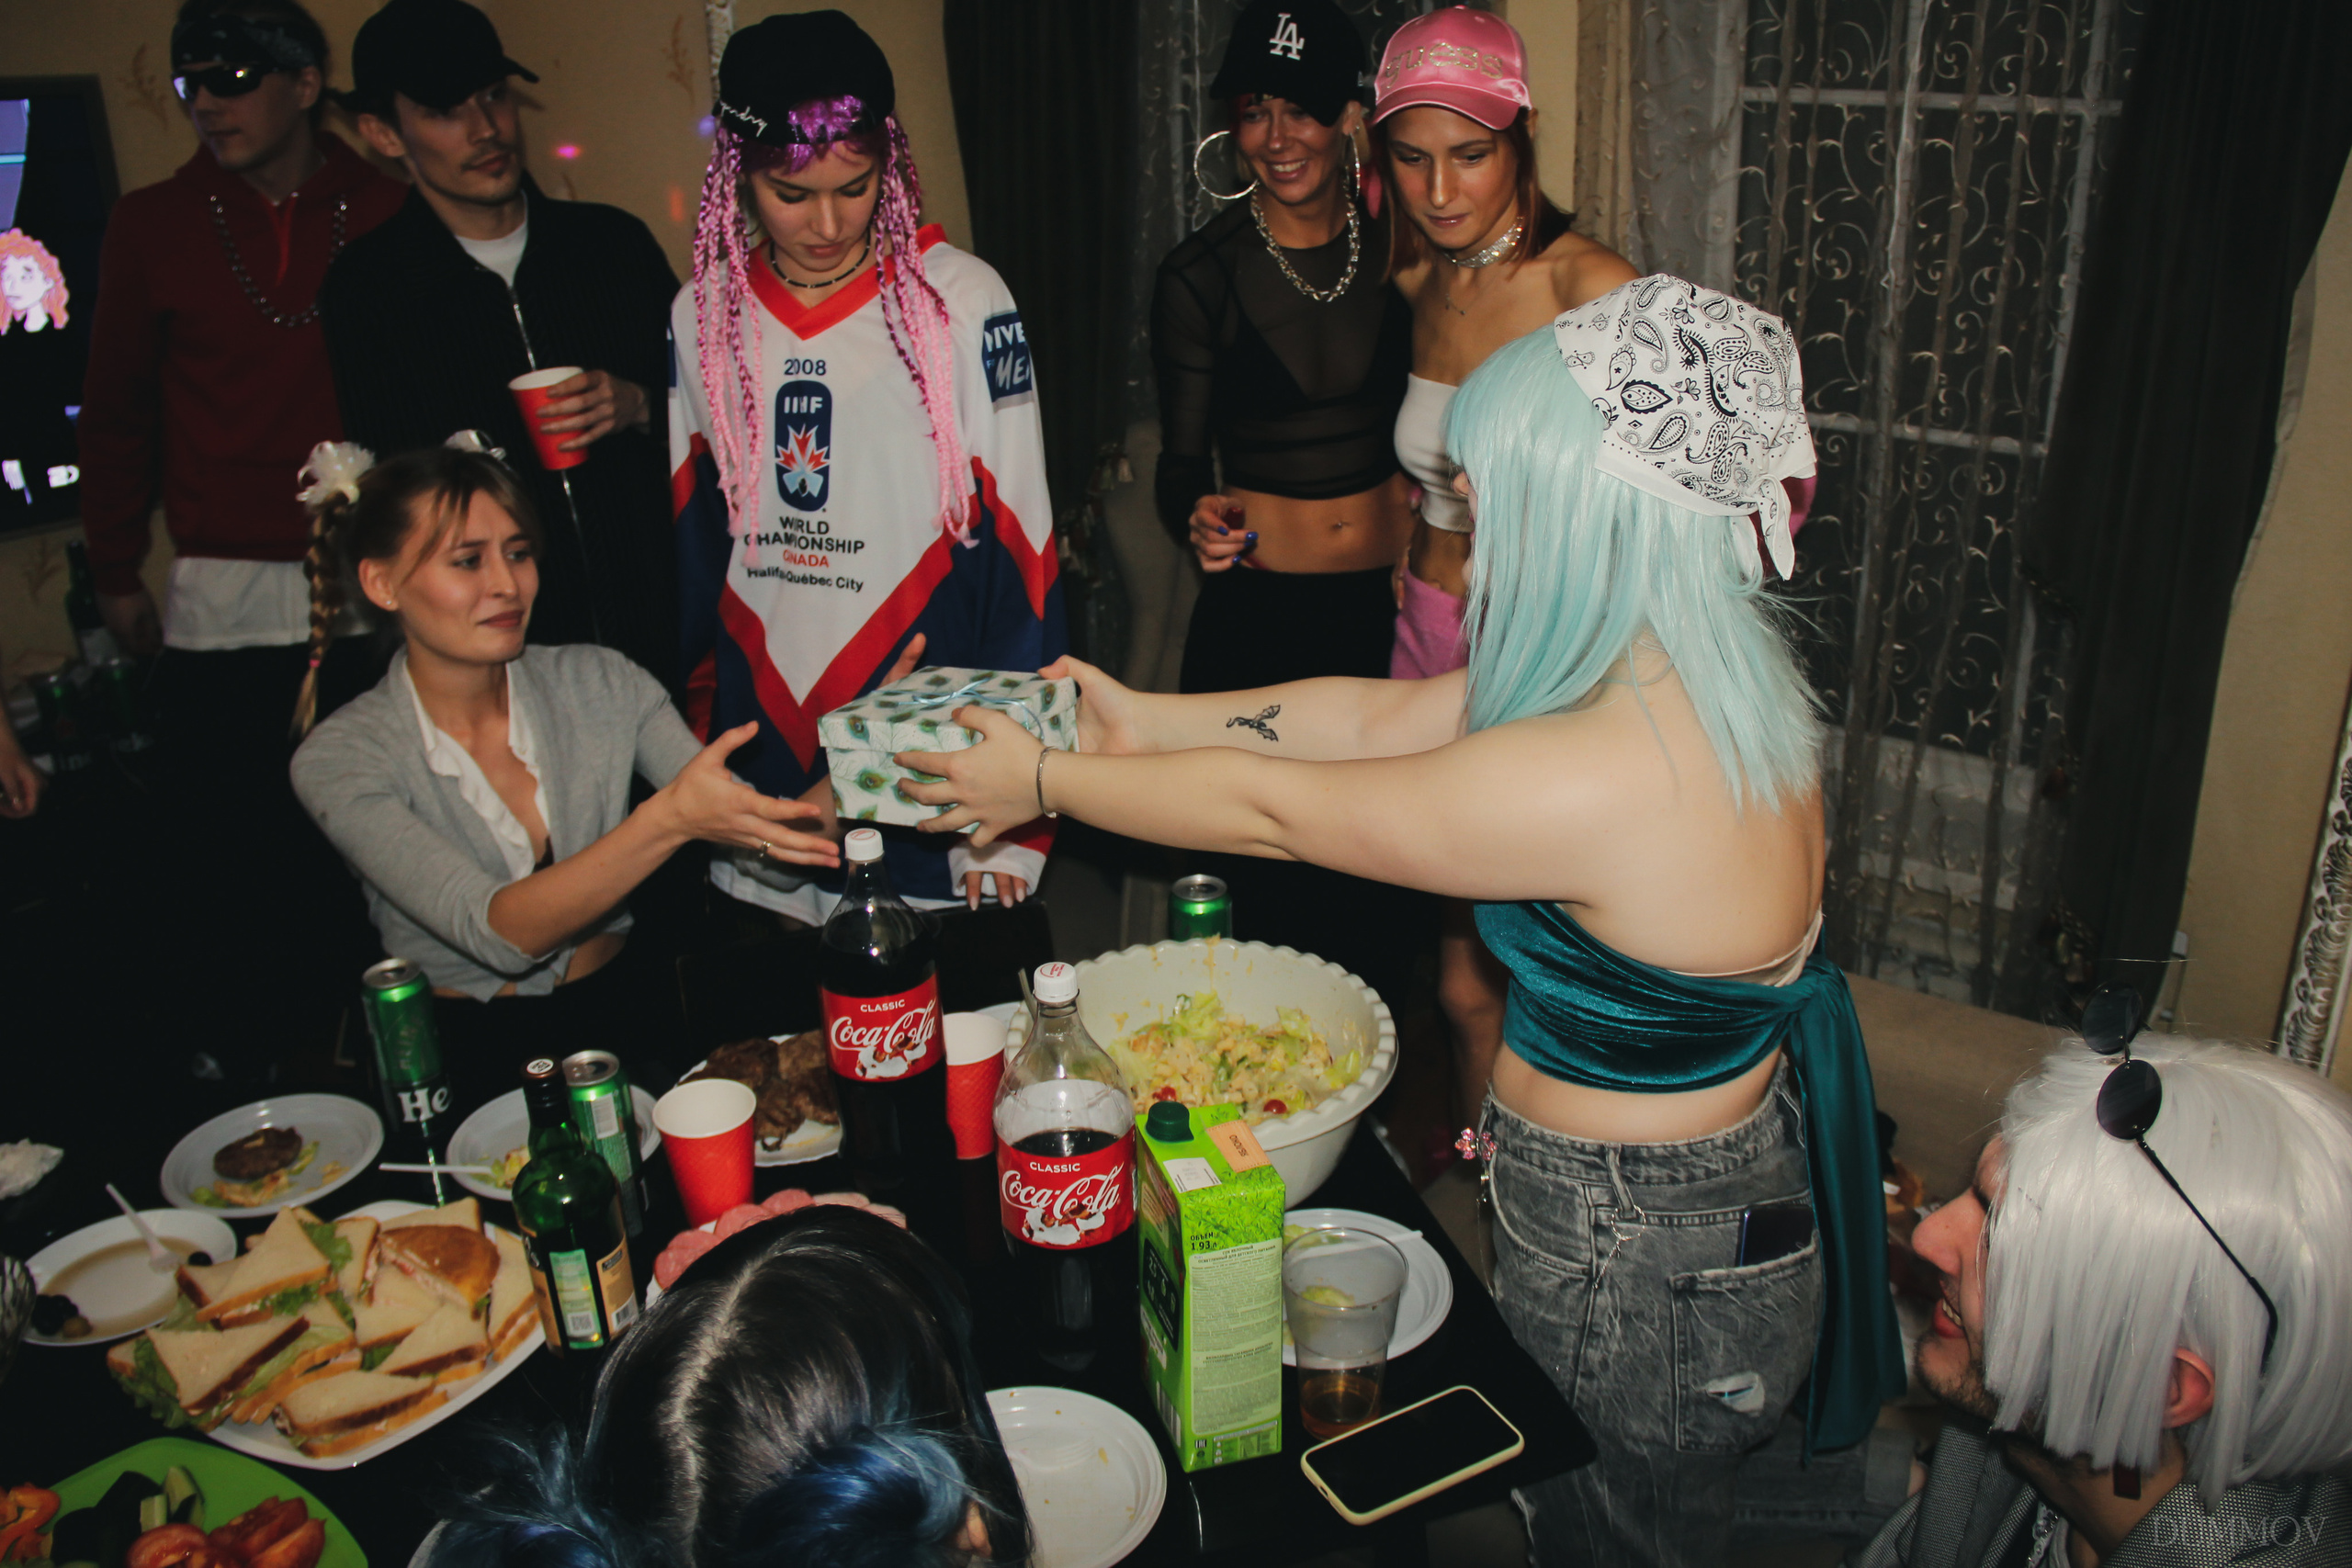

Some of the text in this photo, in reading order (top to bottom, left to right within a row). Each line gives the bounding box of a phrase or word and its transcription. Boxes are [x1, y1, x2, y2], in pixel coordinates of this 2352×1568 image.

[1270, 13, 1305, 61] LA
[1385, 42, 1504, 89] guess
[784, 358, 827, 376] 2008
[995, 350, 1030, 390] ME
[779, 516, 830, 535] WRLD
[836, 577, 864, 592] City
[860, 999, 905, 1012] CLASSIC
[831, 998, 936, 1054] Coca-Cola
[1030, 1162, 1080, 1173] CLASSIC
[1001, 1162, 1125, 1220] Coca-Cola
